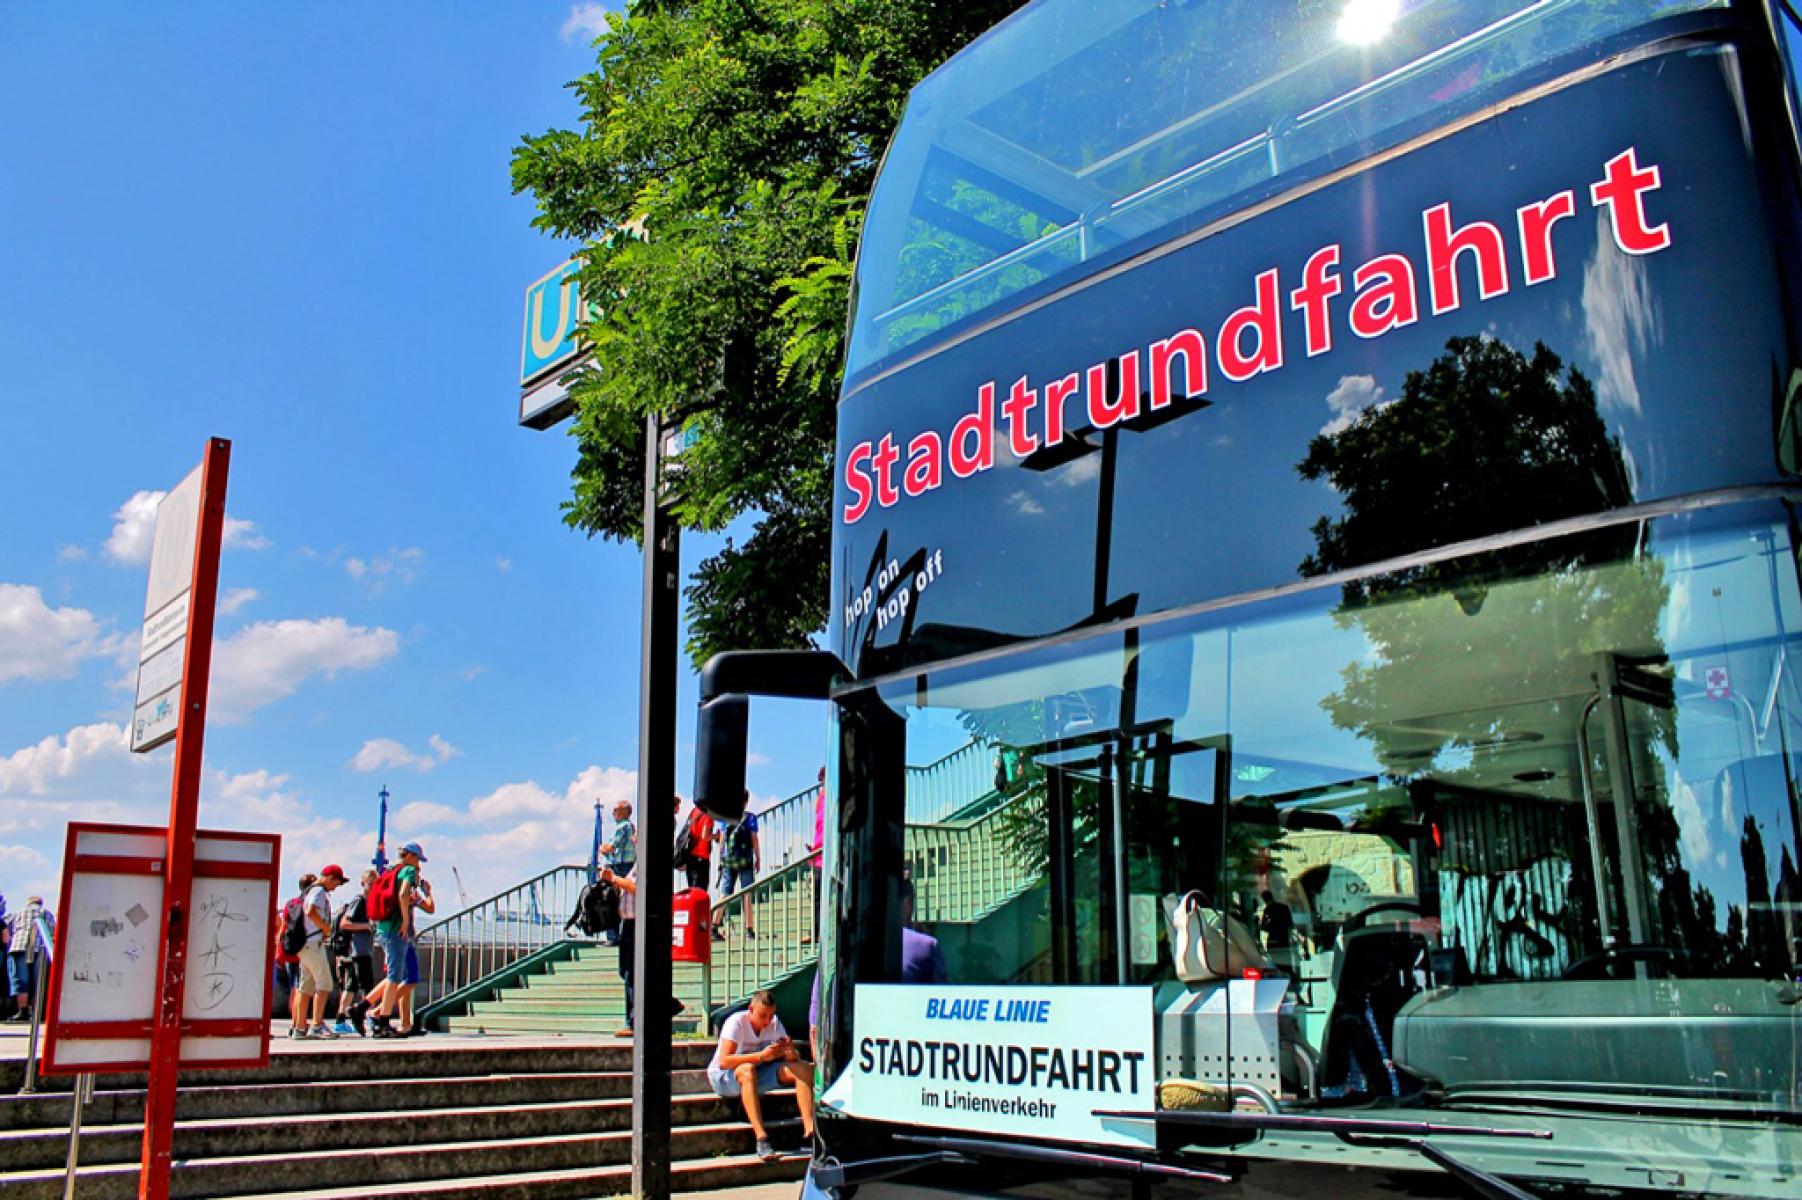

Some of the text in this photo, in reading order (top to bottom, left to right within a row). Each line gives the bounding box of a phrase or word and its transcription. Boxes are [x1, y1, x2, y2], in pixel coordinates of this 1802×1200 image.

[531, 271, 572, 359] U
[843, 147, 1671, 524] Stadtrundfahrt
[845, 558, 900, 628] hop on
[876, 548, 943, 630] hop off
[926, 998, 1050, 1022] BLAUE LINIE
[859, 1037, 1144, 1094] STADTRUNDFAHRT
[921, 1088, 1057, 1118] im Linienverkehr
